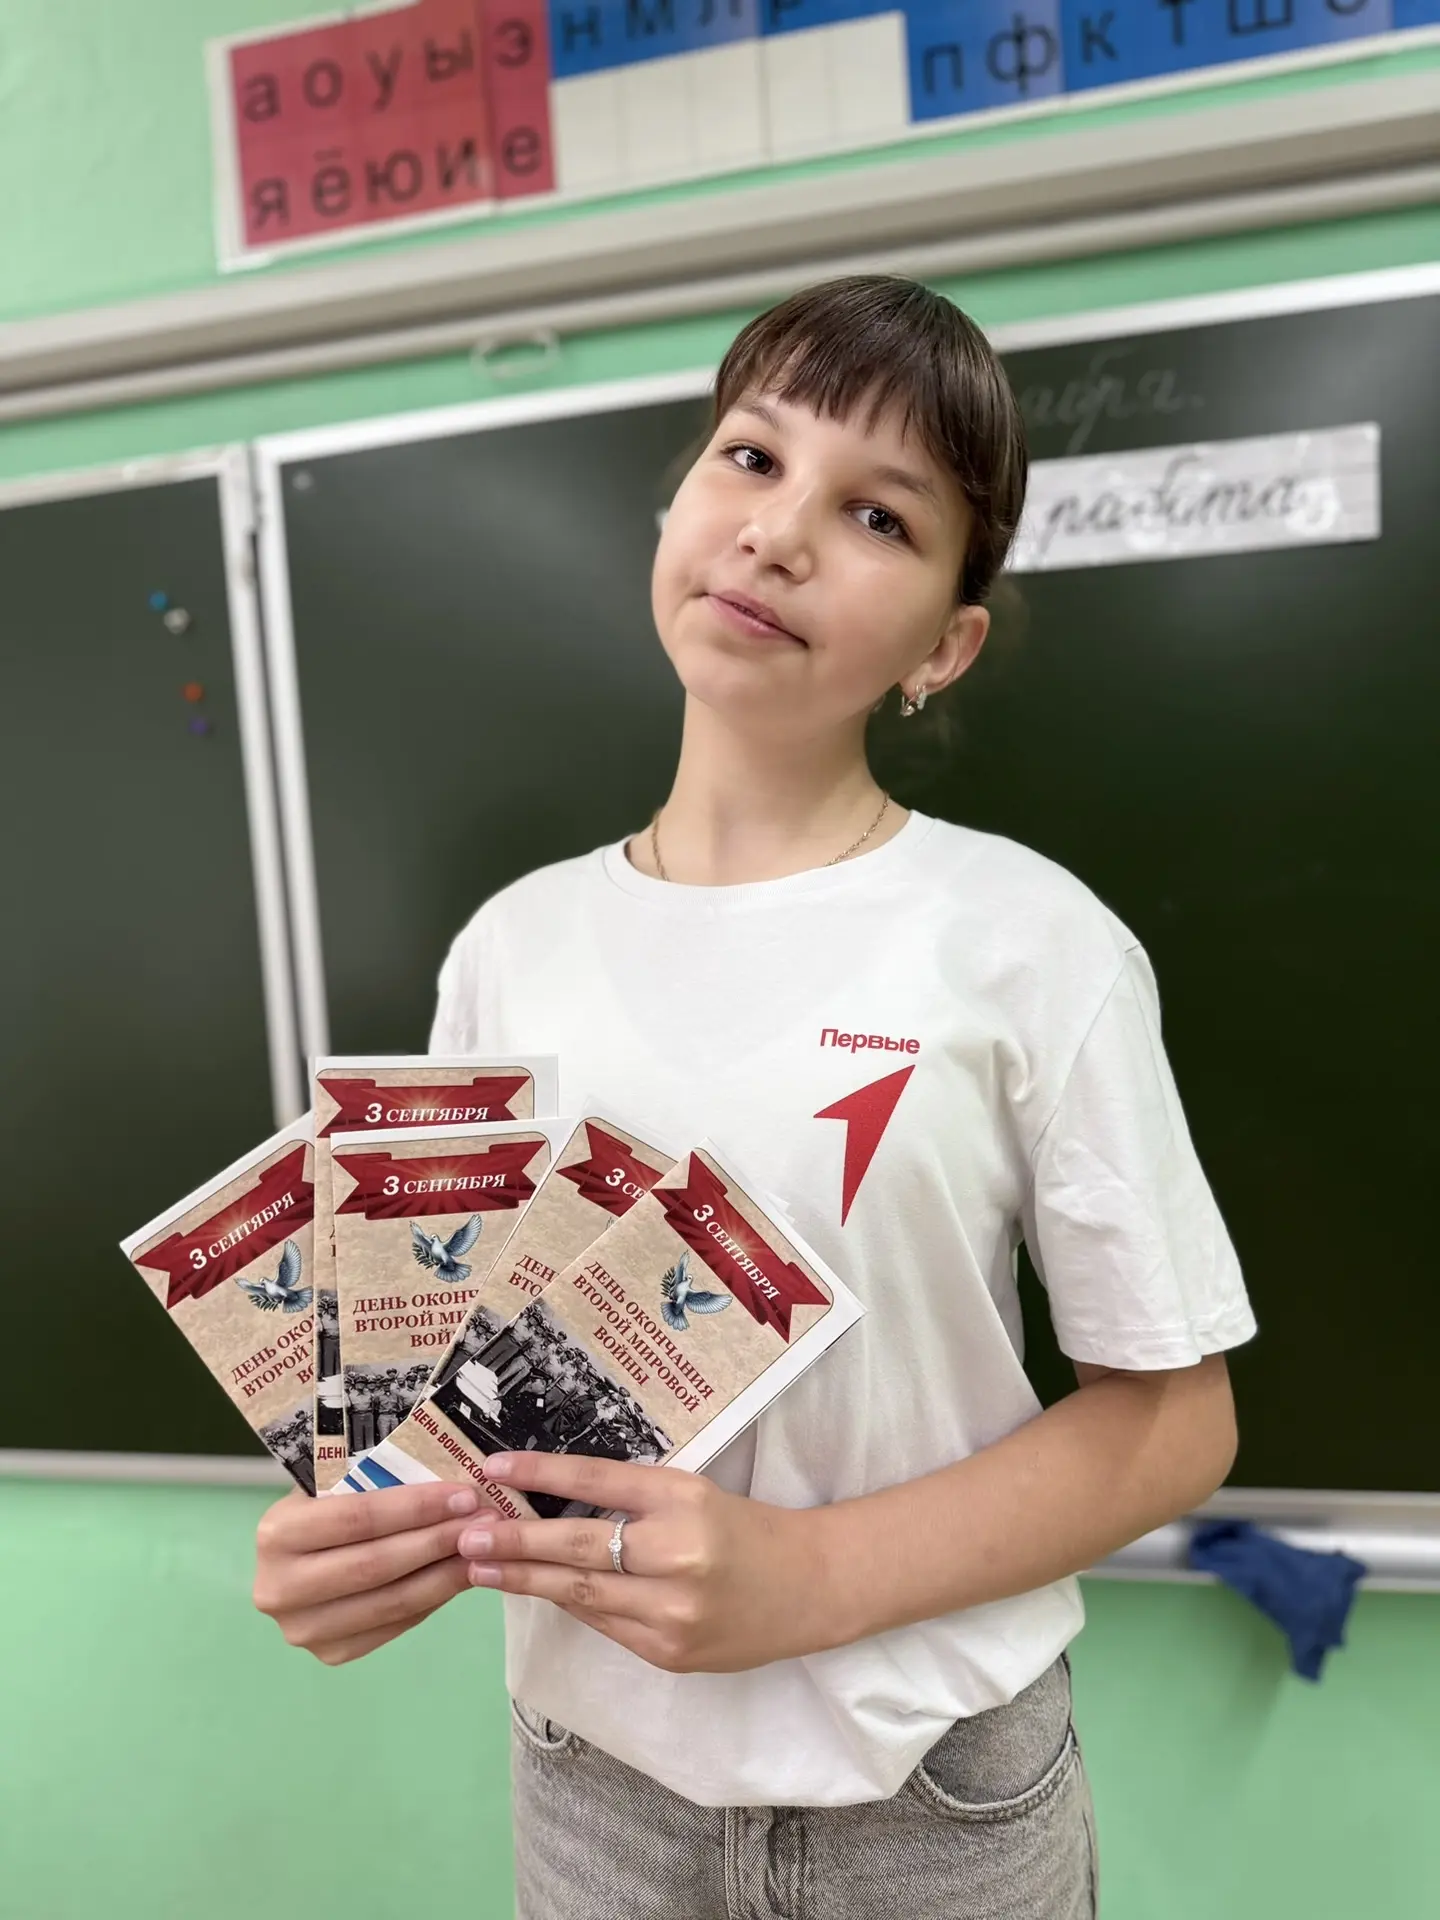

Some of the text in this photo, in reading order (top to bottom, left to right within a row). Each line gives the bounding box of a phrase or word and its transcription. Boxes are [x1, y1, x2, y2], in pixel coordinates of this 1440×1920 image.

[820, 1028, 921, 1054] Первые
[364, 1102, 490, 1123] 3 СЕНТЯБРЯ
[382, 1173, 507, 1196] 3 СЕНТЯБРЯ
[605, 1167, 647, 1201] 3 СЕ
[189, 1247, 208, 1270] 3
[208, 1191, 296, 1259] СЕНТЯБРЯ
[693, 1204, 781, 1300] 3 СЕНТЯБРЯ
[507, 1271, 543, 1297] ВТО
[515, 1254, 559, 1283] ДЕН
[352, 1289, 480, 1315] ДЕНЬ ОКОНЧ
[354, 1310, 433, 1333] ВТОРОЙ
[584, 1261, 715, 1400] ДЕНЬ ОКОНЧАНИЯ
[231, 1347, 277, 1384] ДЕНЬ
[276, 1313, 314, 1349] ОКО
[410, 1329, 455, 1348] ВОЙ
[572, 1274, 700, 1413] ВТОРОЙ МИРОВОЙ
[241, 1344, 309, 1398] ВТОРОЙ
[592, 1325, 651, 1387] ВОЙНЫ
[317, 1446, 346, 1461] ДЕН
[413, 1408, 439, 1436] ДЕНЬ
[485, 1483, 522, 1520] СЛАВЫ
